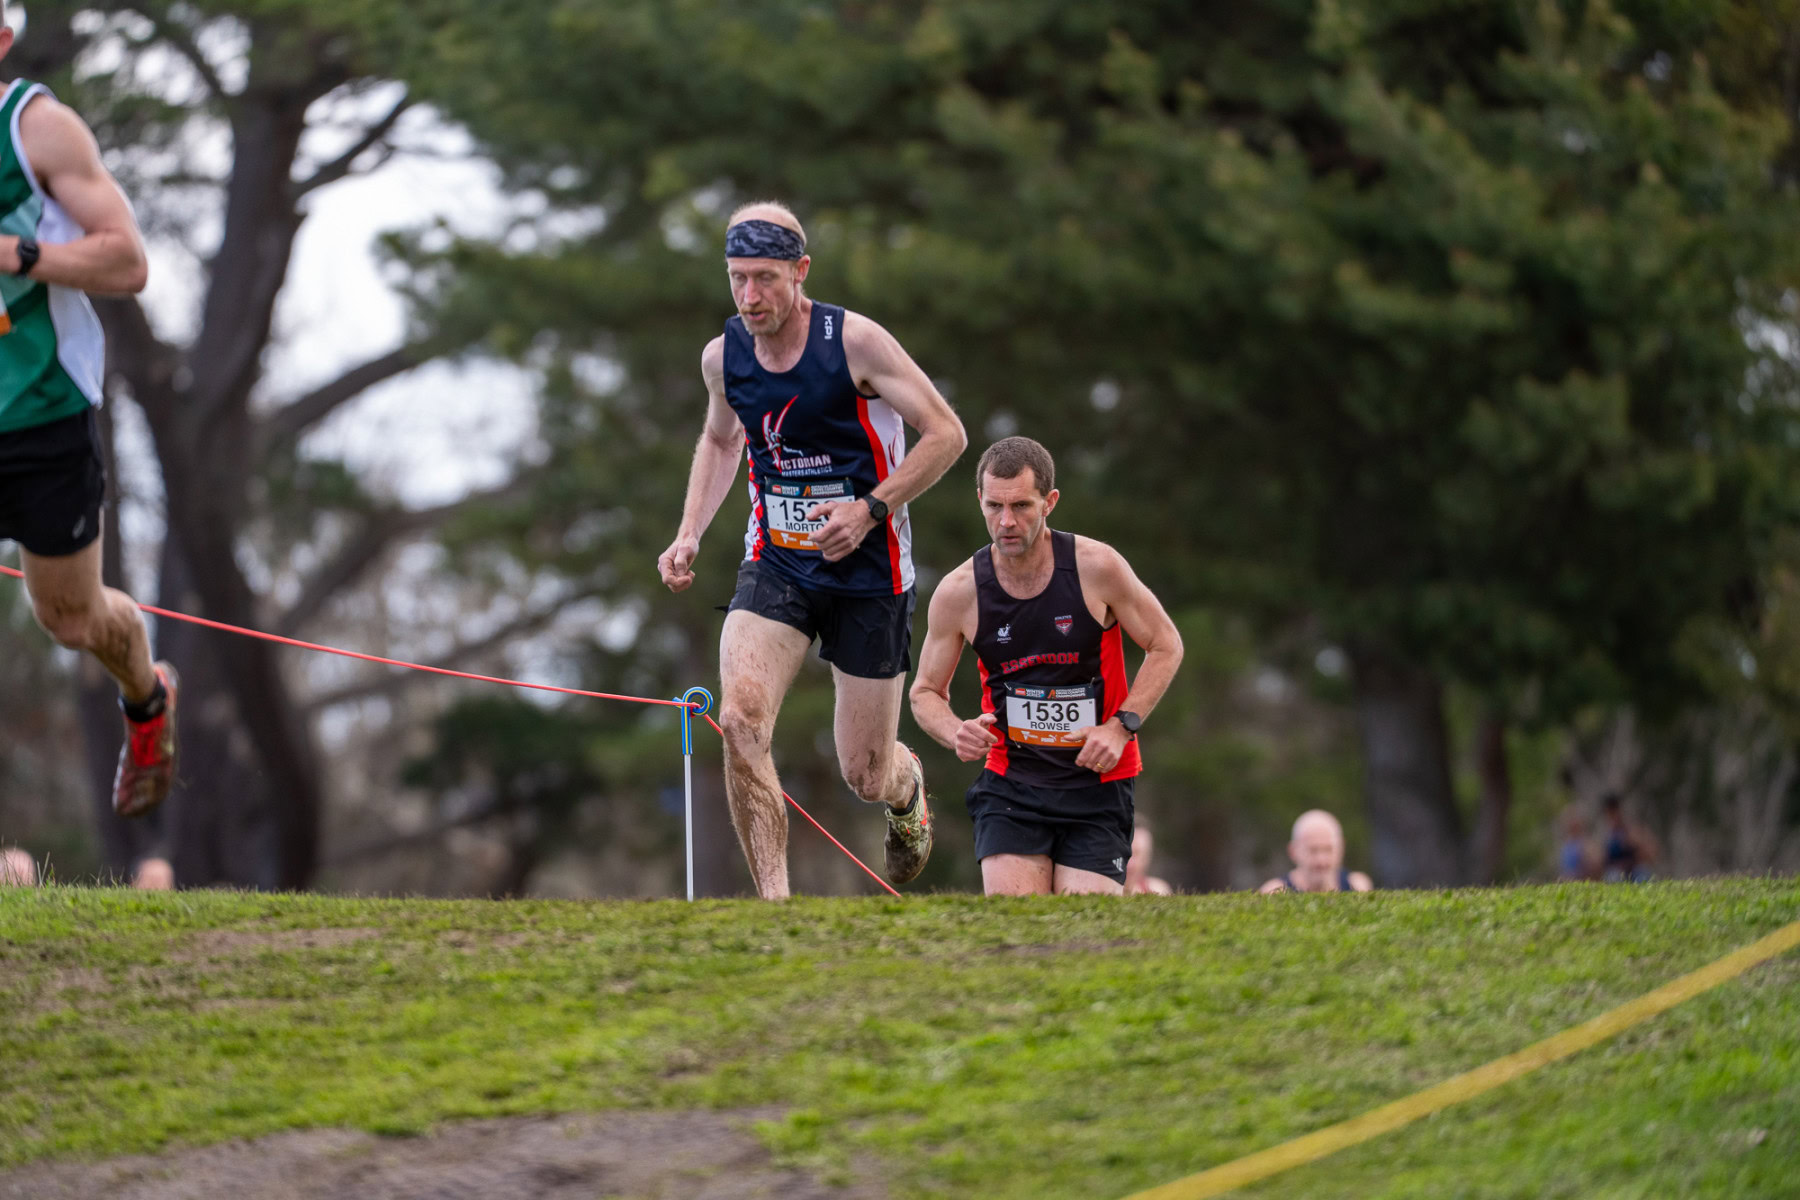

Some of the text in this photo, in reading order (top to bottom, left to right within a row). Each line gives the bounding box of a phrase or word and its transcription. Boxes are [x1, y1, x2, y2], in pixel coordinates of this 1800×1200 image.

[779, 499, 832, 522] 152
[1000, 652, 1080, 674] ESSENDON
[1021, 701, 1080, 722] 1536
[1030, 721, 1071, 731] ROWSE
